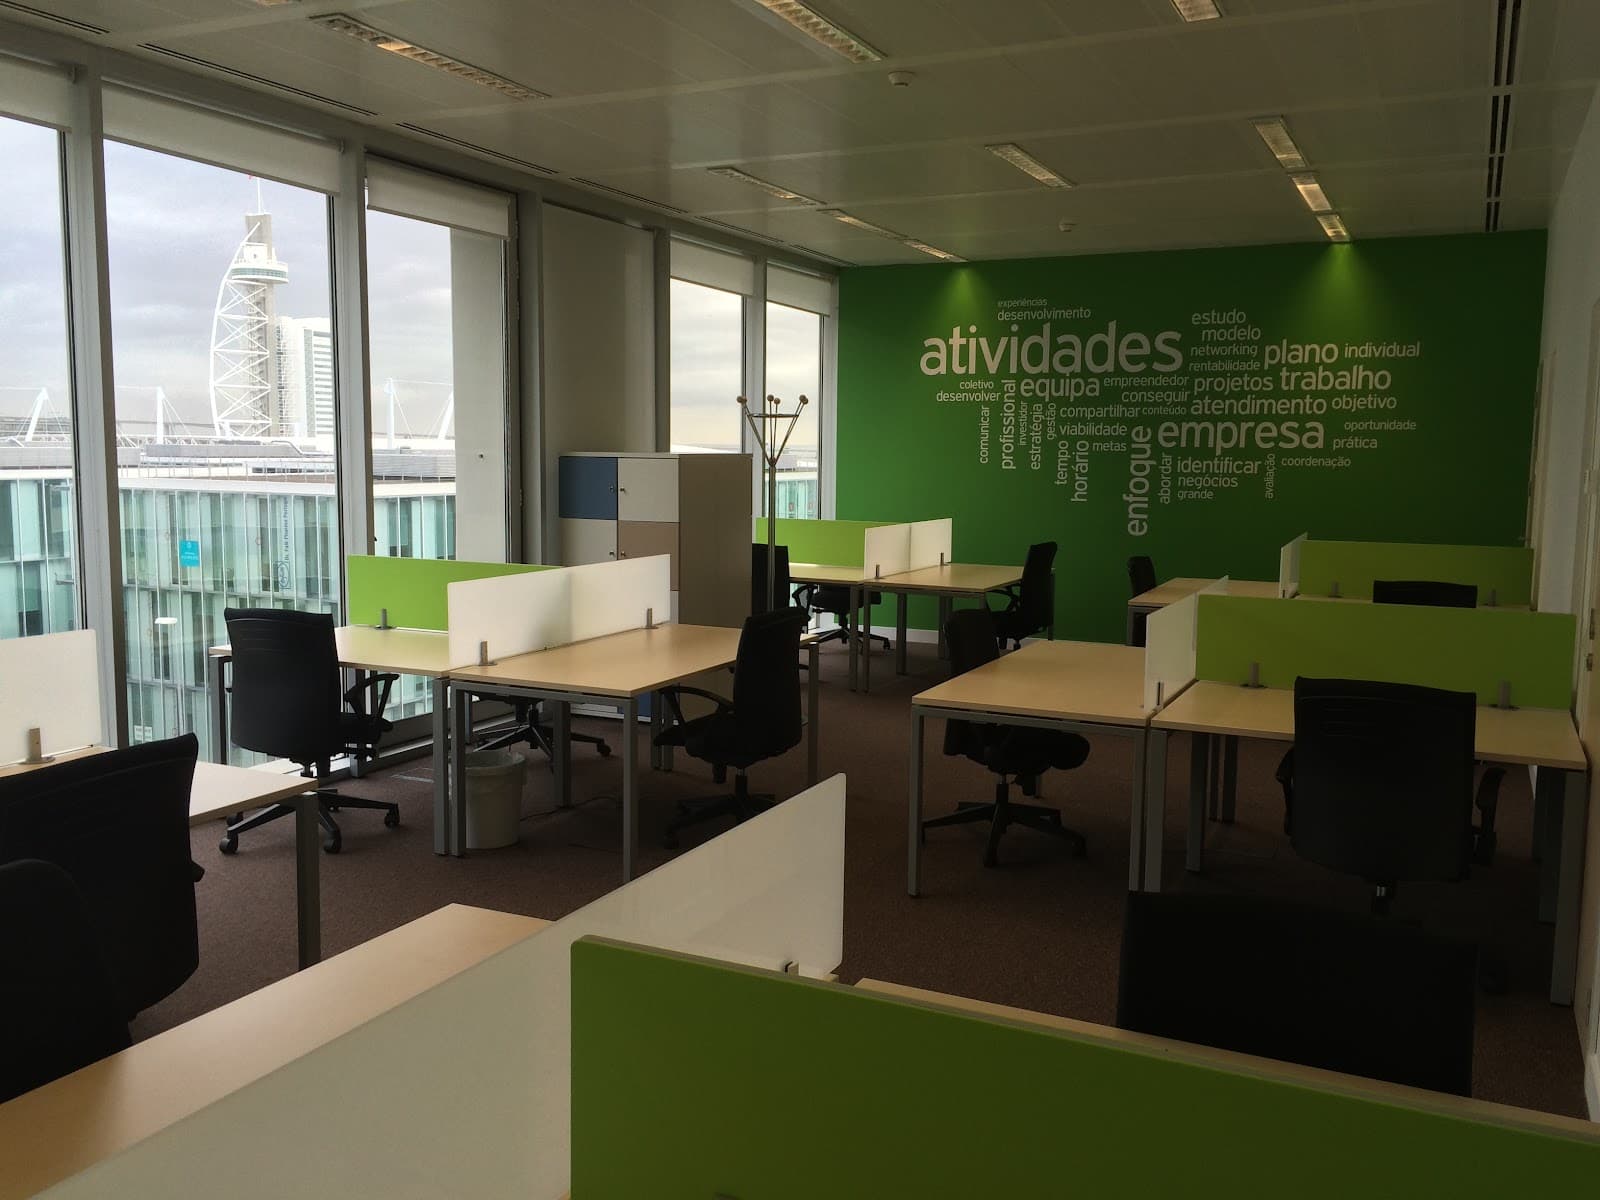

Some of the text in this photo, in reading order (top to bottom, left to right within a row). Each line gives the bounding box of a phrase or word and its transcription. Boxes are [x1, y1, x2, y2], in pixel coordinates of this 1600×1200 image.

[997, 297, 1048, 308] experiências
[997, 307, 1091, 321] desenvolvimento
[1192, 309, 1246, 325] estudo
[1202, 325, 1261, 341] modelo
[920, 320, 1184, 375] atividades
[1191, 343, 1259, 358] networking
[1264, 339, 1339, 369] plano
[1344, 342, 1420, 358] individual
[1189, 360, 1261, 371] rentabilidade
[960, 380, 994, 390] coletivo
[1103, 376, 1189, 388] empreendedor
[1194, 374, 1273, 395] projetos
[1280, 365, 1391, 391] trabalho
[936, 391, 1001, 402] desenvolver
[1020, 376, 1100, 402] equipa
[1122, 390, 1190, 405] conseguir
[1191, 396, 1327, 415] atendimento
[1332, 394, 1397, 412] objetivo
[1060, 403, 1141, 419] compartilhar
[1143, 405, 1187, 416] conteúdo
[999, 379, 1017, 471] profissional
[1019, 401, 1027, 446] investidor
[1045, 402, 1056, 440] gestão
[1059, 422, 1127, 436] viabilidade
[1344, 420, 1417, 432] oportunidade
[979, 406, 990, 464] comunicar
[1030, 403, 1043, 470] estratégia
[1157, 420, 1324, 456] empresa
[1332, 436, 1378, 450] prática
[1092, 442, 1127, 452] metas
[1055, 440, 1071, 485] tempo
[1177, 457, 1262, 474] identificar
[1281, 456, 1351, 468] coordenação
[1071, 440, 1089, 502] horário
[1158, 452, 1172, 504] abordar
[1264, 453, 1275, 499] avaliação
[1122, 425, 1157, 536] enfoque
[1178, 473, 1239, 489] negócios
[1178, 490, 1214, 500] grande
